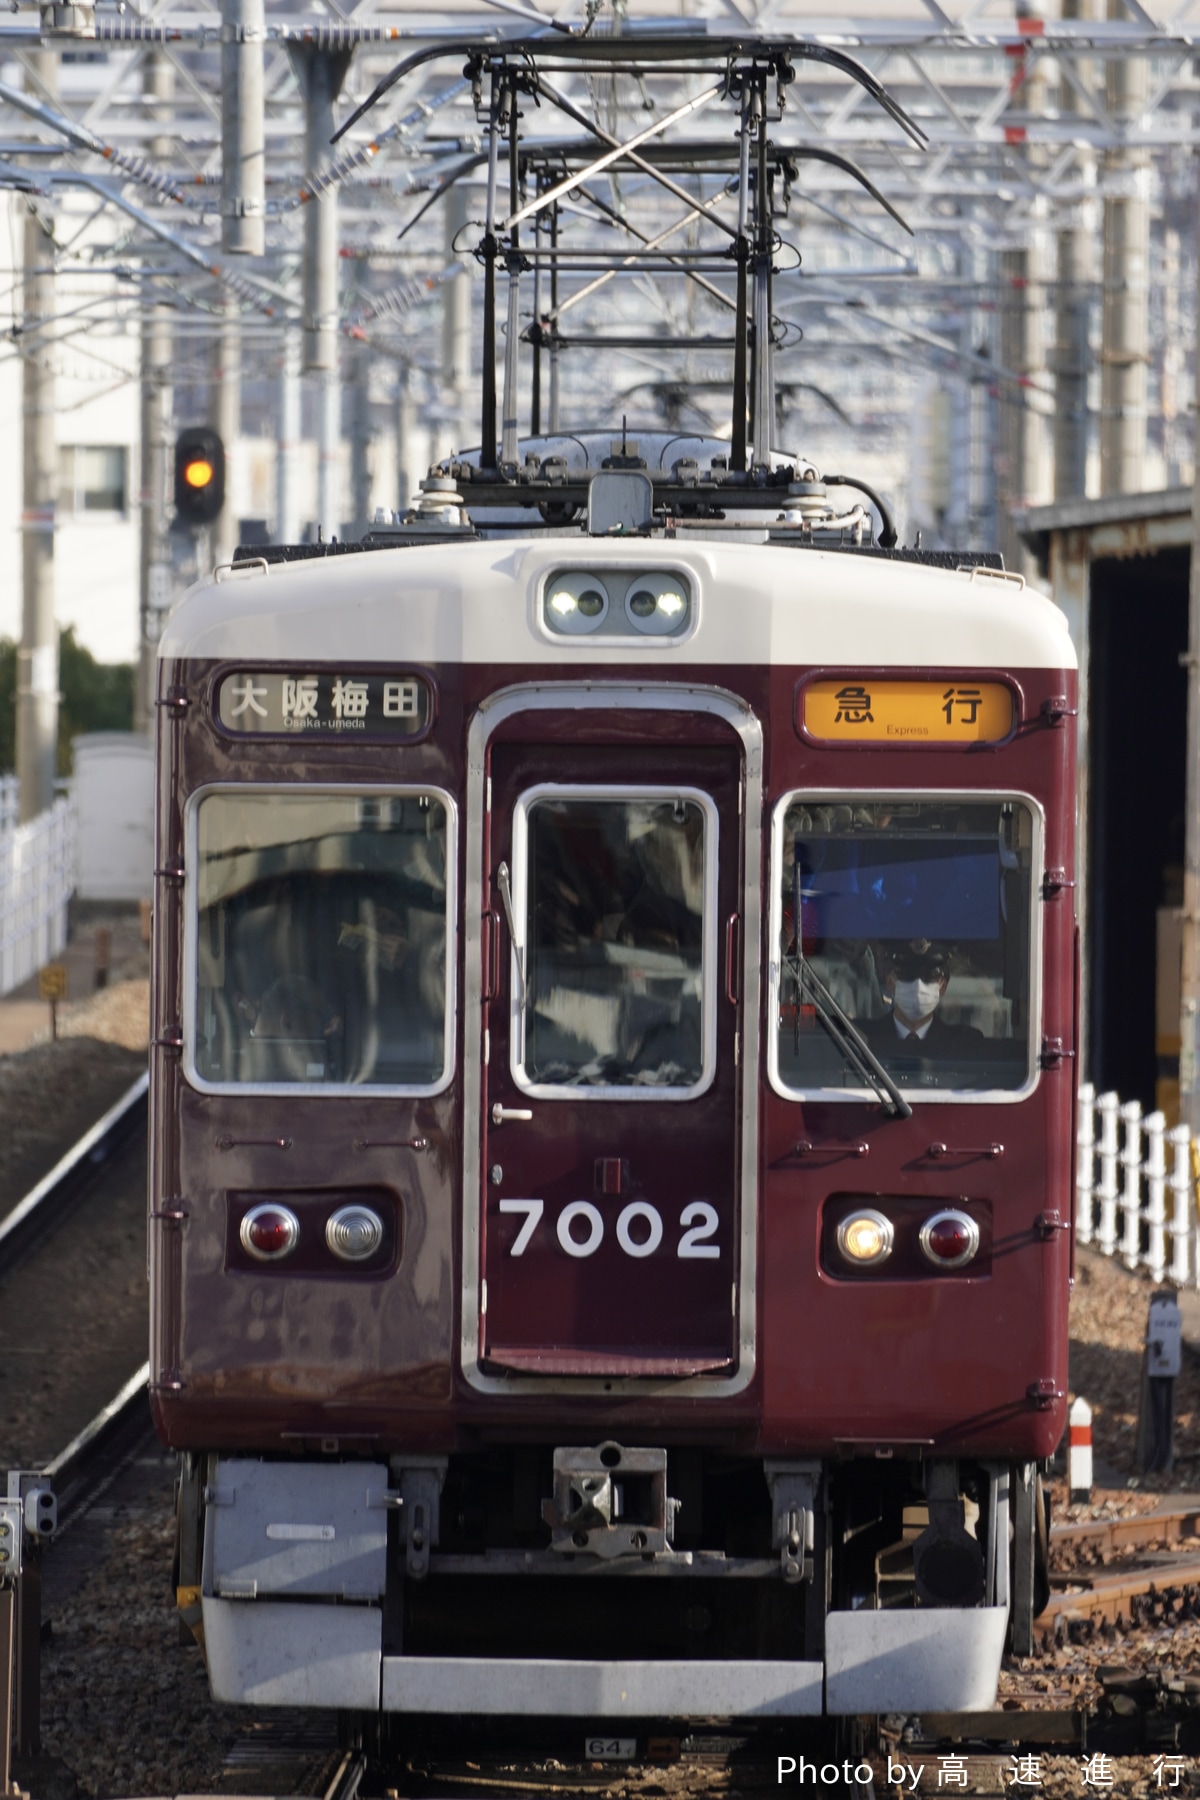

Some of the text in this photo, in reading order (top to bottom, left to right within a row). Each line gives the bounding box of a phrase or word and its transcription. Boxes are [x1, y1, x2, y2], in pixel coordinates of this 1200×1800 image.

[231, 679, 418, 717] 大阪梅田
[834, 687, 983, 724] 急行
[283, 717, 366, 729] Osaka-umeda
[886, 724, 929, 736] Express
[499, 1199, 720, 1258] 7002
